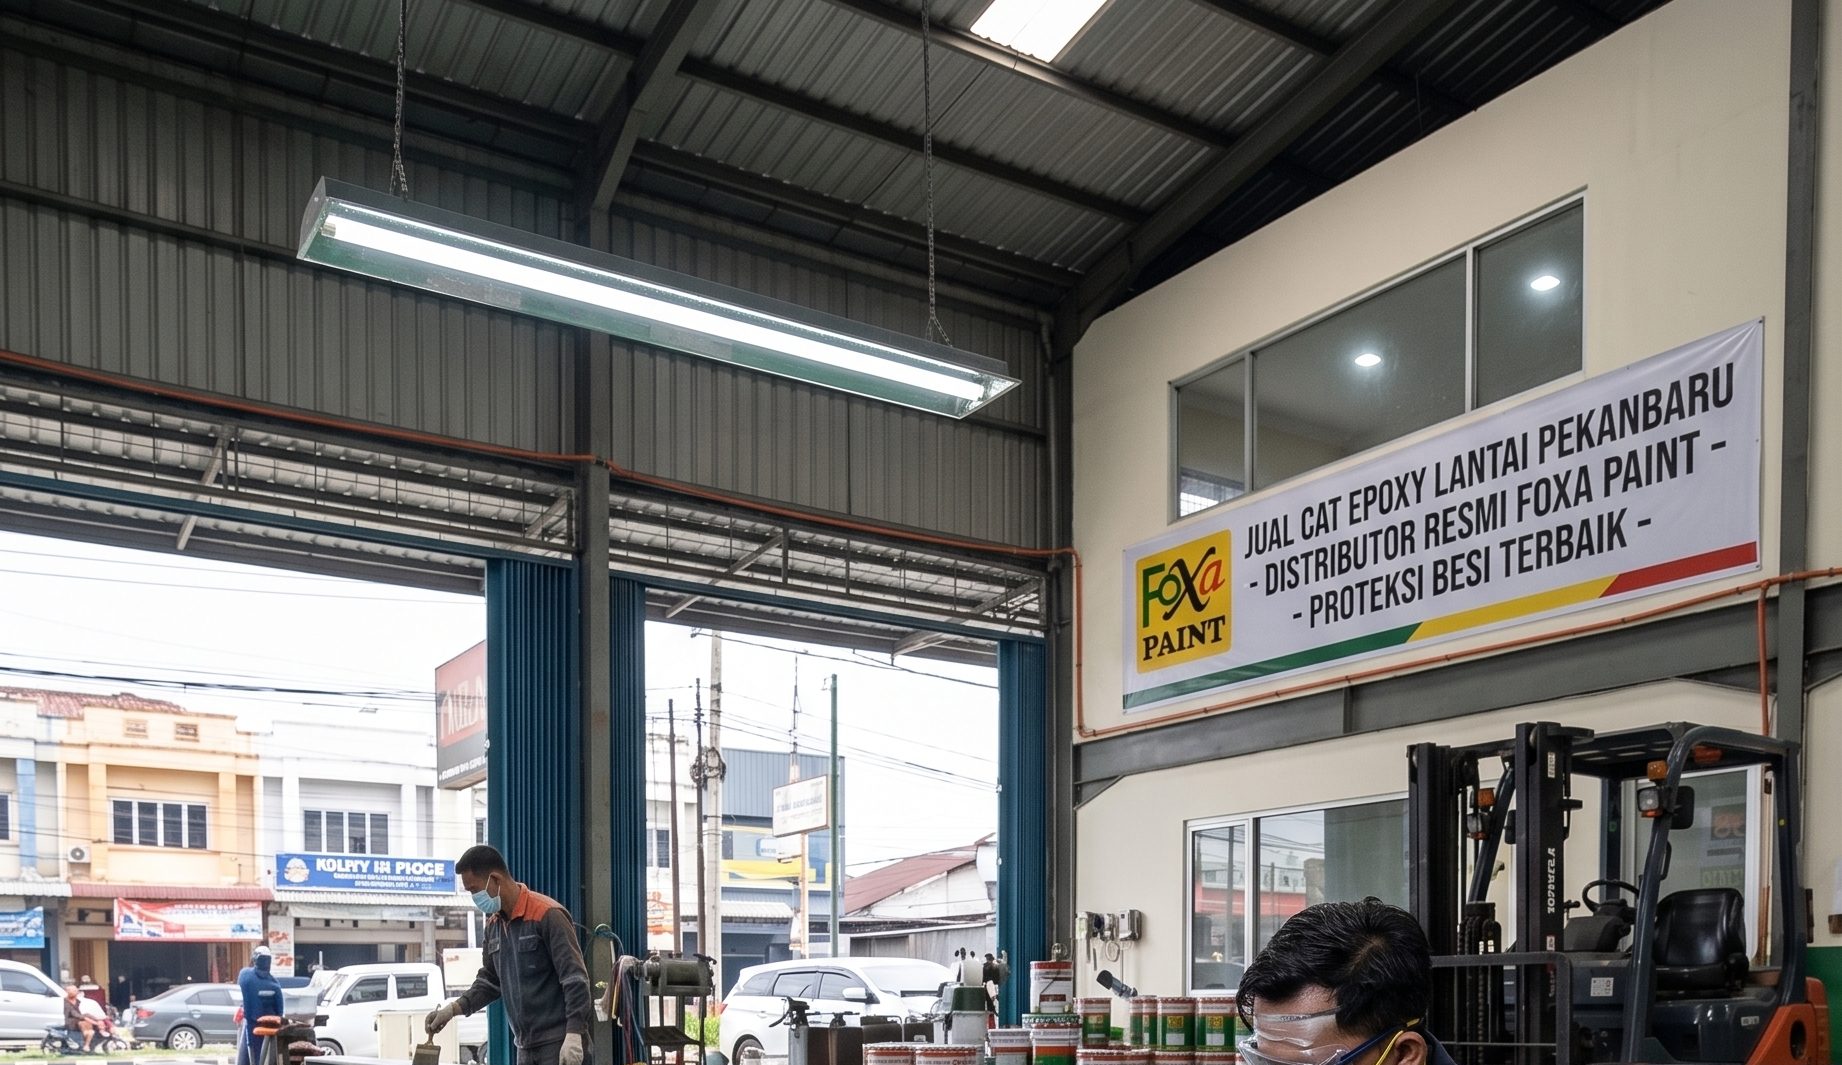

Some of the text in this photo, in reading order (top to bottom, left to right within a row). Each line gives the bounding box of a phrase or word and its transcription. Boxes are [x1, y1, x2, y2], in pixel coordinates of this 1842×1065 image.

[1244, 362, 1735, 560] JUAL CAT EPOXY LANTAI PEKANBARU
[1265, 520, 1416, 597] DISTRIBUTOR
[1424, 490, 1507, 550] RESMI
[1516, 464, 1594, 523] FOXA
[1603, 430, 1701, 498] PAINT
[1142, 614, 1226, 662] PAINT
[1310, 564, 1424, 629] PROTEKSI
[1432, 545, 1491, 597] BESI
[1499, 507, 1628, 579] TERBAIK
